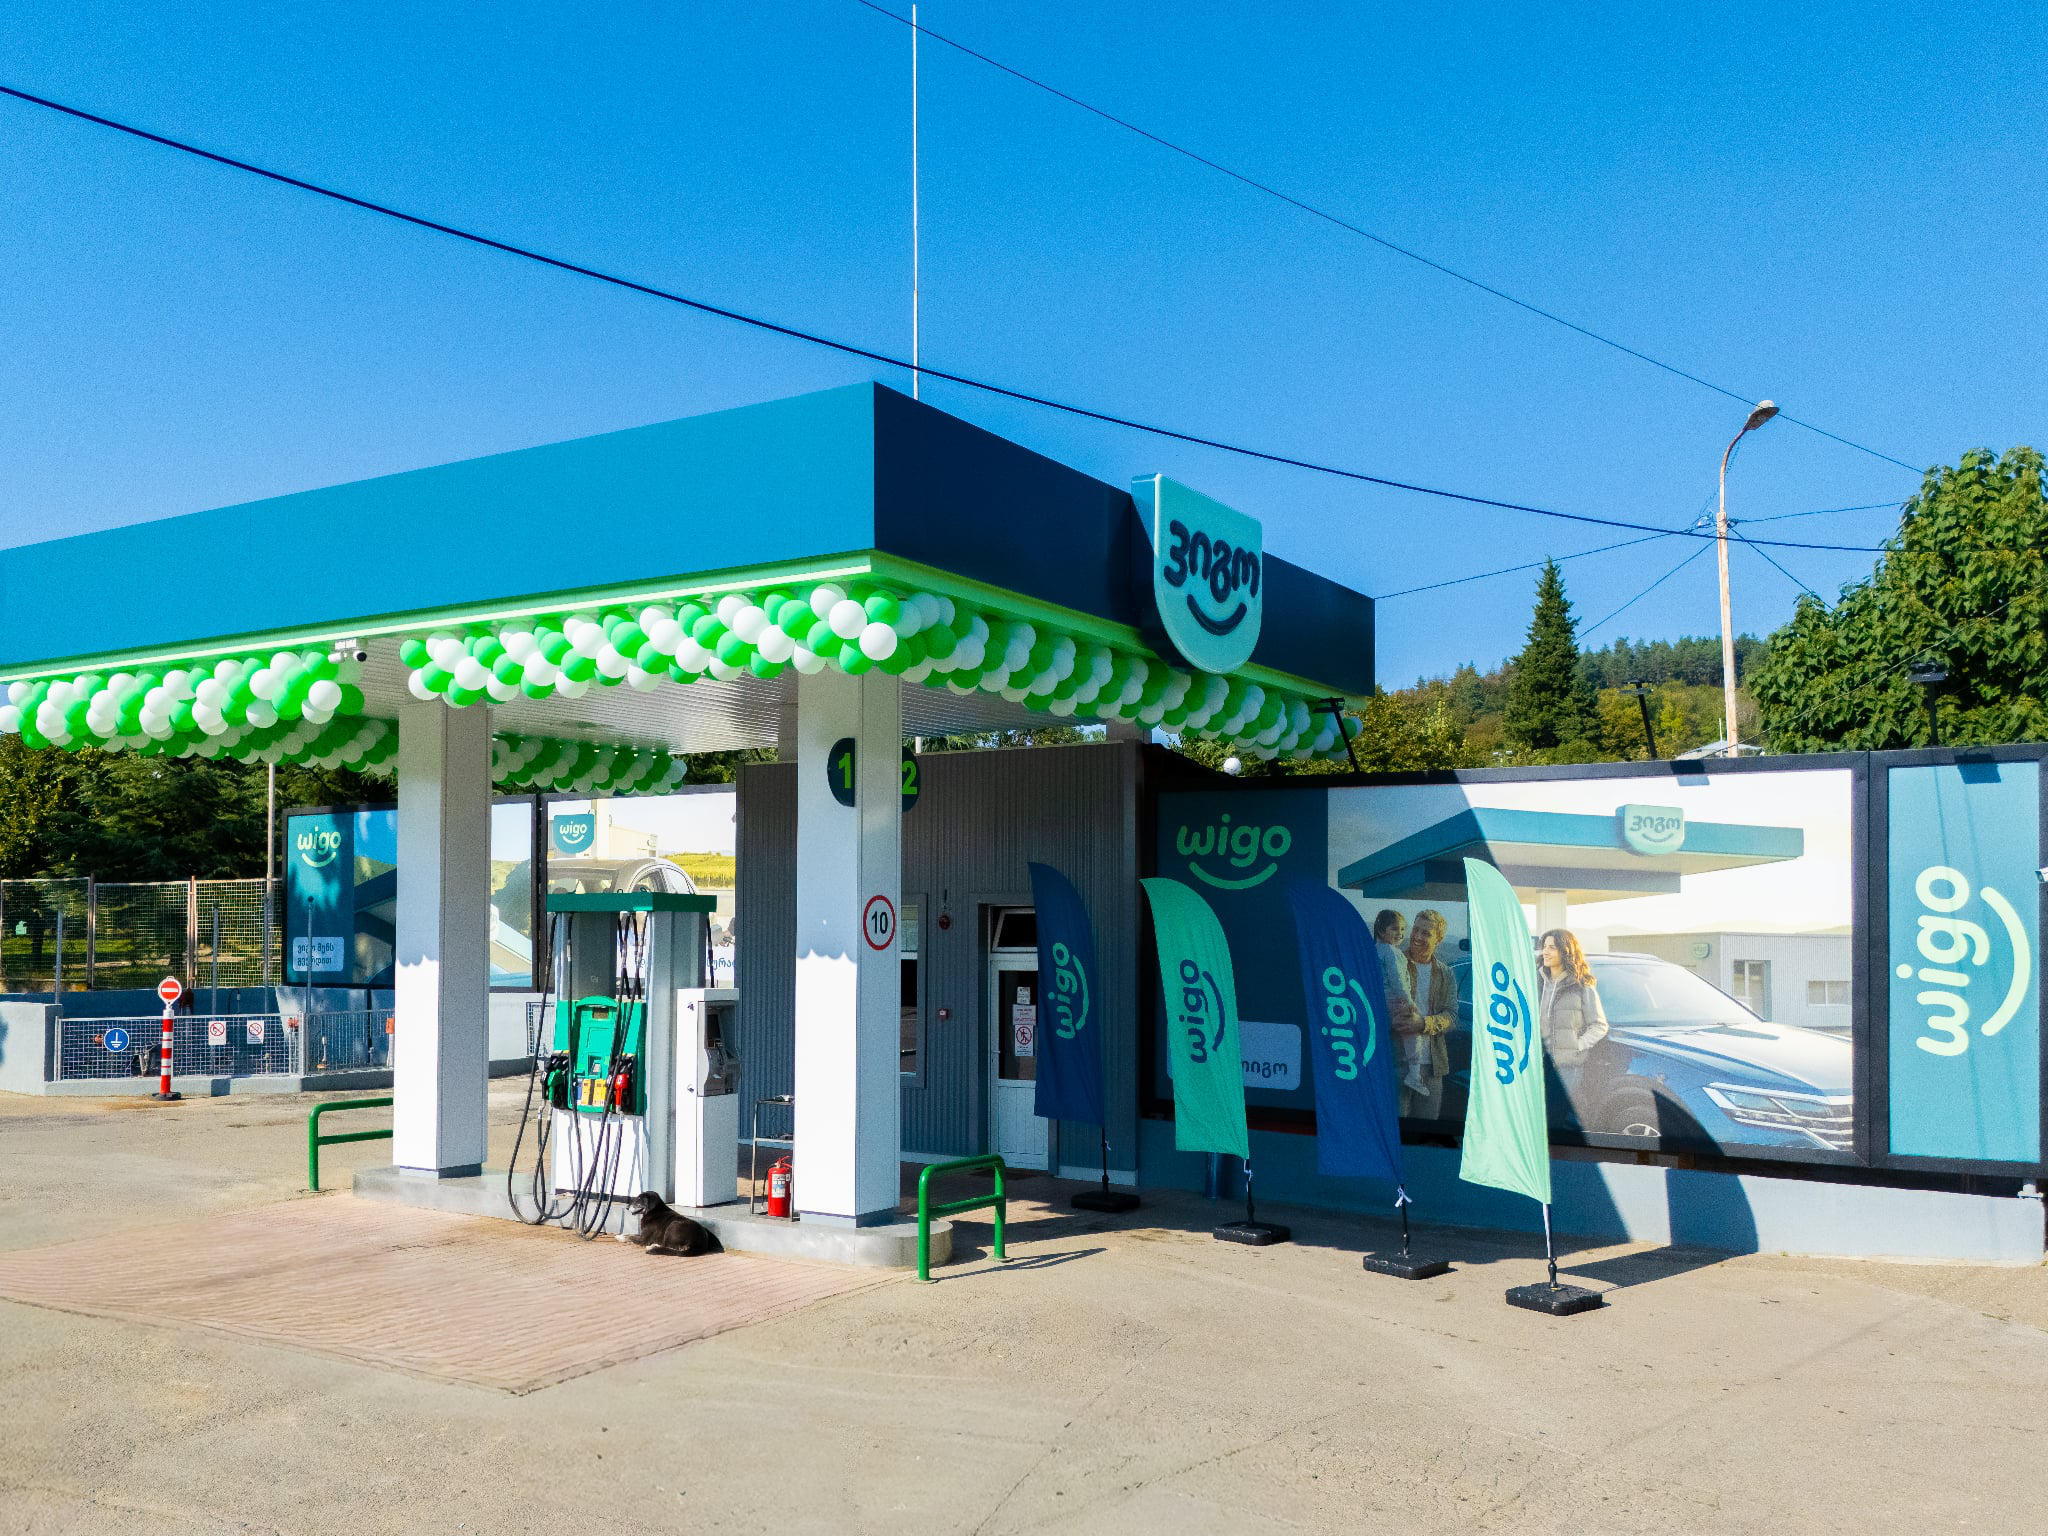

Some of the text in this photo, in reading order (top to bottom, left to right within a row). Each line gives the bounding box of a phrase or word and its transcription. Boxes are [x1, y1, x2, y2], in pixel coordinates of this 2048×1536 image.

[1164, 520, 1260, 603] ვიგო
[838, 752, 851, 789] 1
[902, 760, 918, 795] 2
[297, 825, 341, 855] wigo
[560, 820, 588, 837] wigo
[1176, 813, 1291, 867] wigo
[871, 910, 888, 934] 10
[1047, 942, 1078, 1039] wigo
[1895, 865, 1990, 1057] wigo
[1179, 959, 1209, 1063] wigo
[1322, 966, 1357, 1080] wigo
[1486, 961, 1518, 1085] wigo
